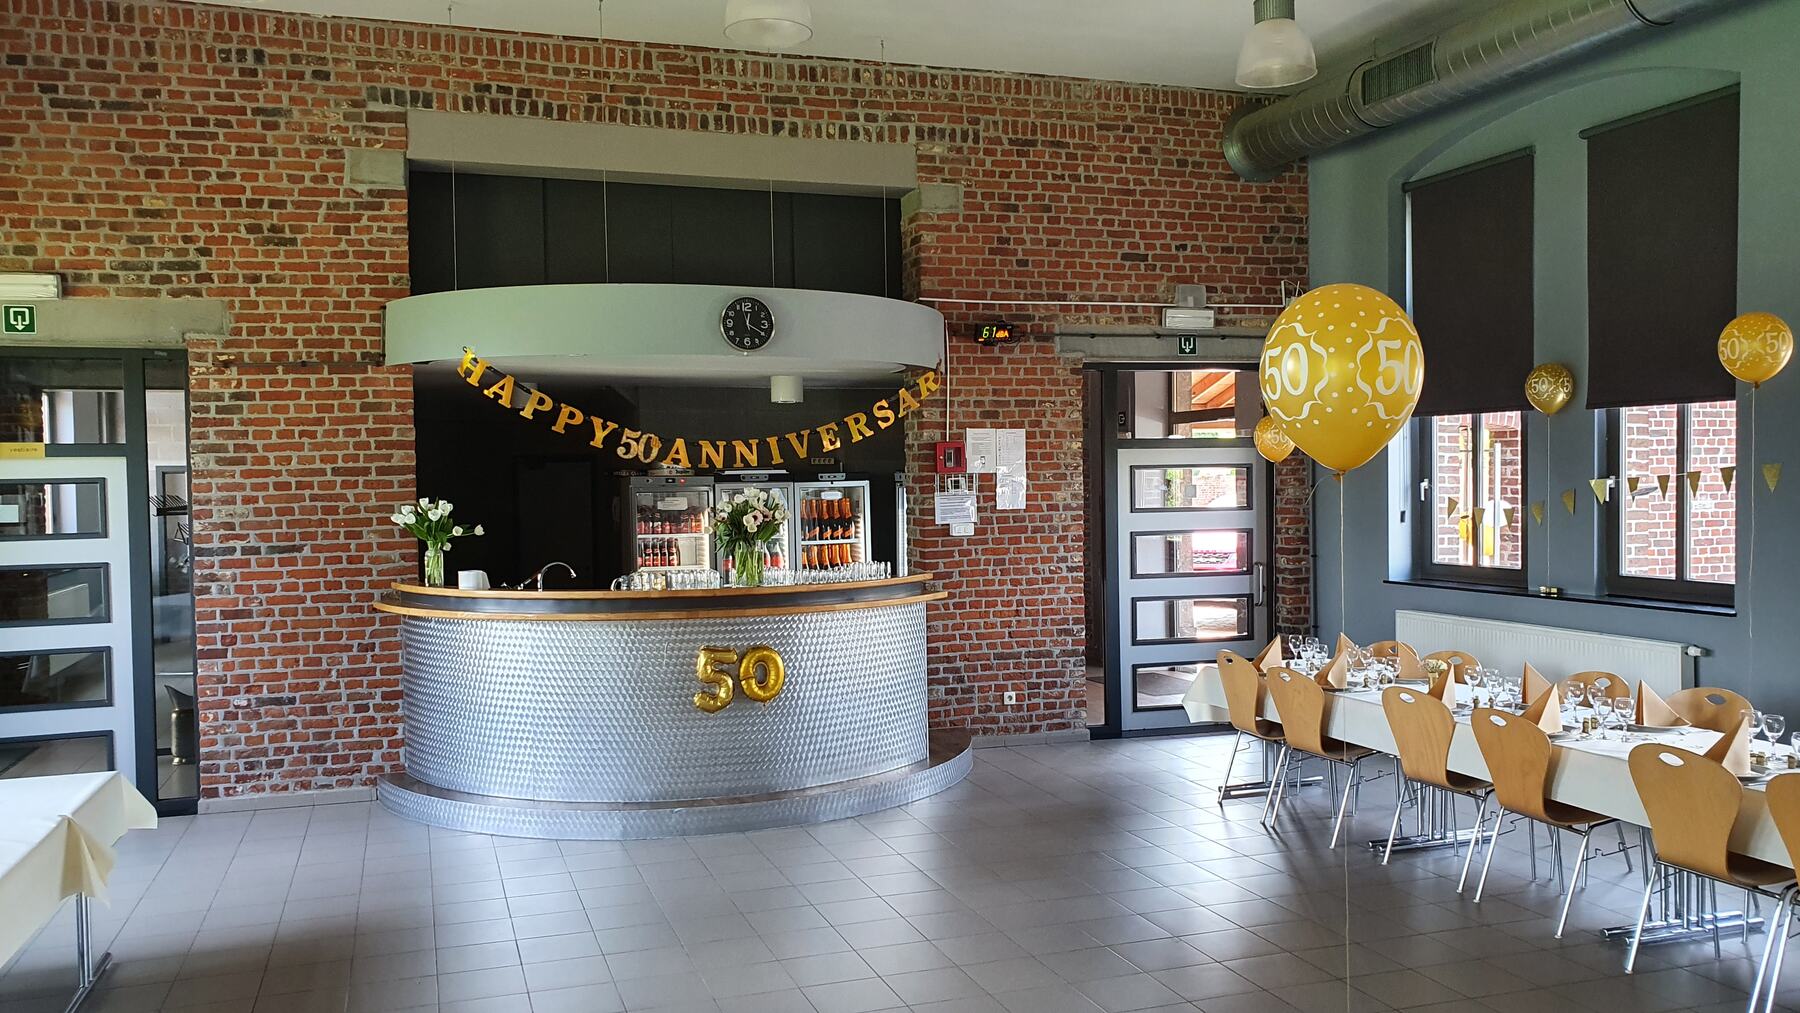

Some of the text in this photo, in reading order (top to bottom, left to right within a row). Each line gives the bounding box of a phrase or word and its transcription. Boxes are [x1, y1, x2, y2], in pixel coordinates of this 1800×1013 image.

[742, 302, 752, 311] 12
[726, 319, 733, 328] 9
[761, 320, 768, 329] 3
[982, 326, 997, 338] 61
[735, 337, 740, 345] 7
[743, 337, 751, 346] 6
[1720, 337, 1740, 361] 50
[1766, 331, 1789, 354] 50
[1264, 342, 1309, 401] 50
[1375, 339, 1421, 396] 50
[1531, 377, 1549, 394] 50
[456, 347, 941, 469] HAPPY 50 ANNIVERSAR
[693, 645, 785, 714] 50
